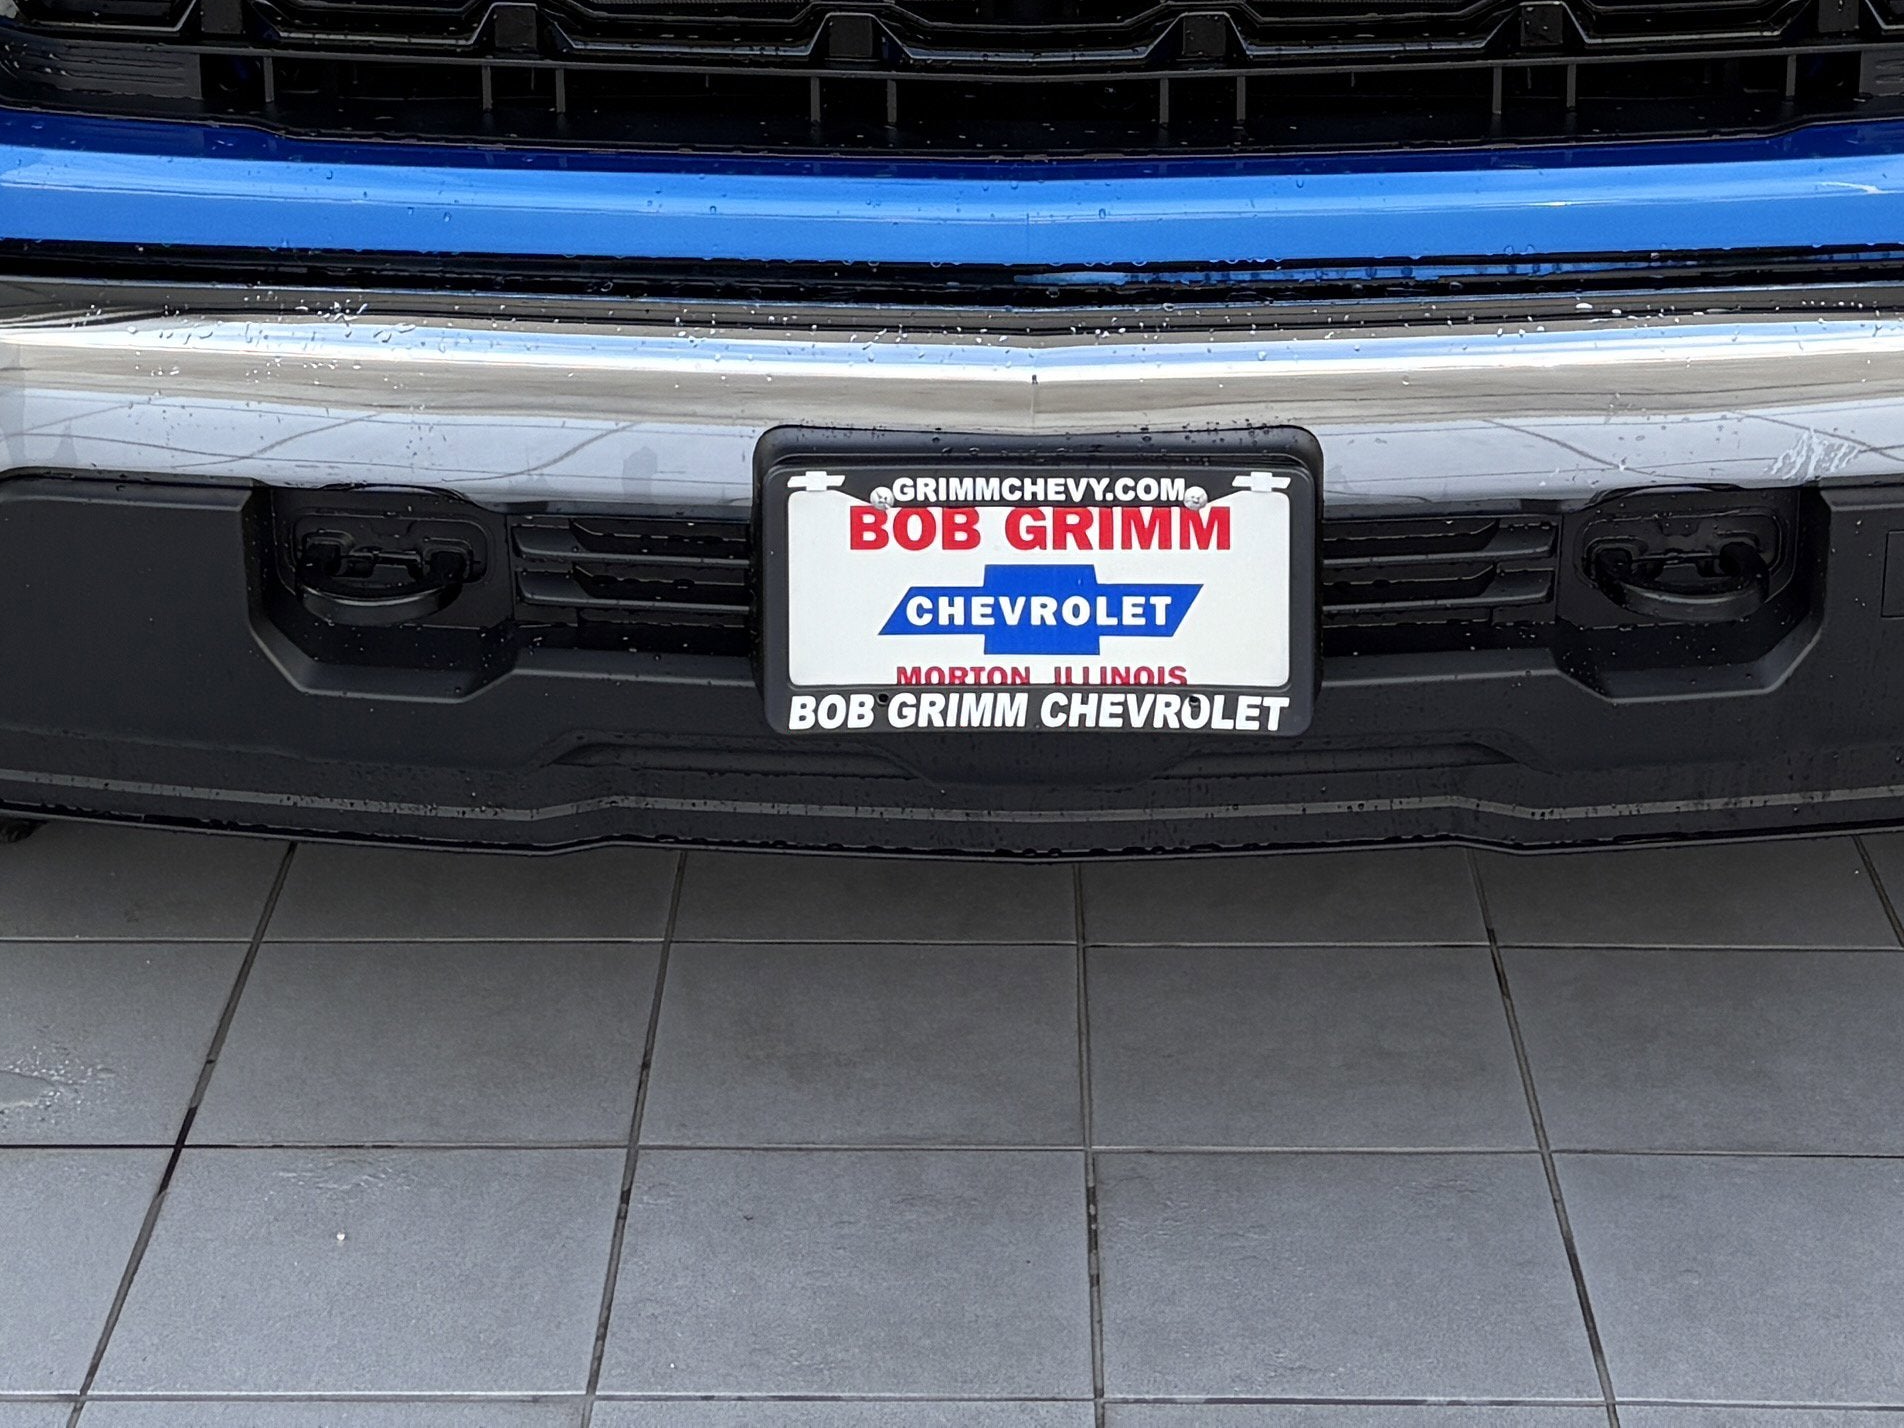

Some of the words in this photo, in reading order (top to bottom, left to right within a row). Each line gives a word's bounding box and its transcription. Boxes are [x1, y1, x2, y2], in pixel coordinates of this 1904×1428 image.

[892, 477, 1185, 502] GRIMMCHEVY.COM
[850, 505, 981, 550] BOB
[1005, 506, 1230, 550] GRIMM
[906, 596, 1172, 626] CHEVROLET
[896, 666, 1030, 685] MORTON
[1054, 666, 1188, 686] ILLINOIS
[788, 693, 875, 730] BOB
[887, 692, 1029, 729] GRIMM
[1040, 692, 1290, 731] CHEVROLET
